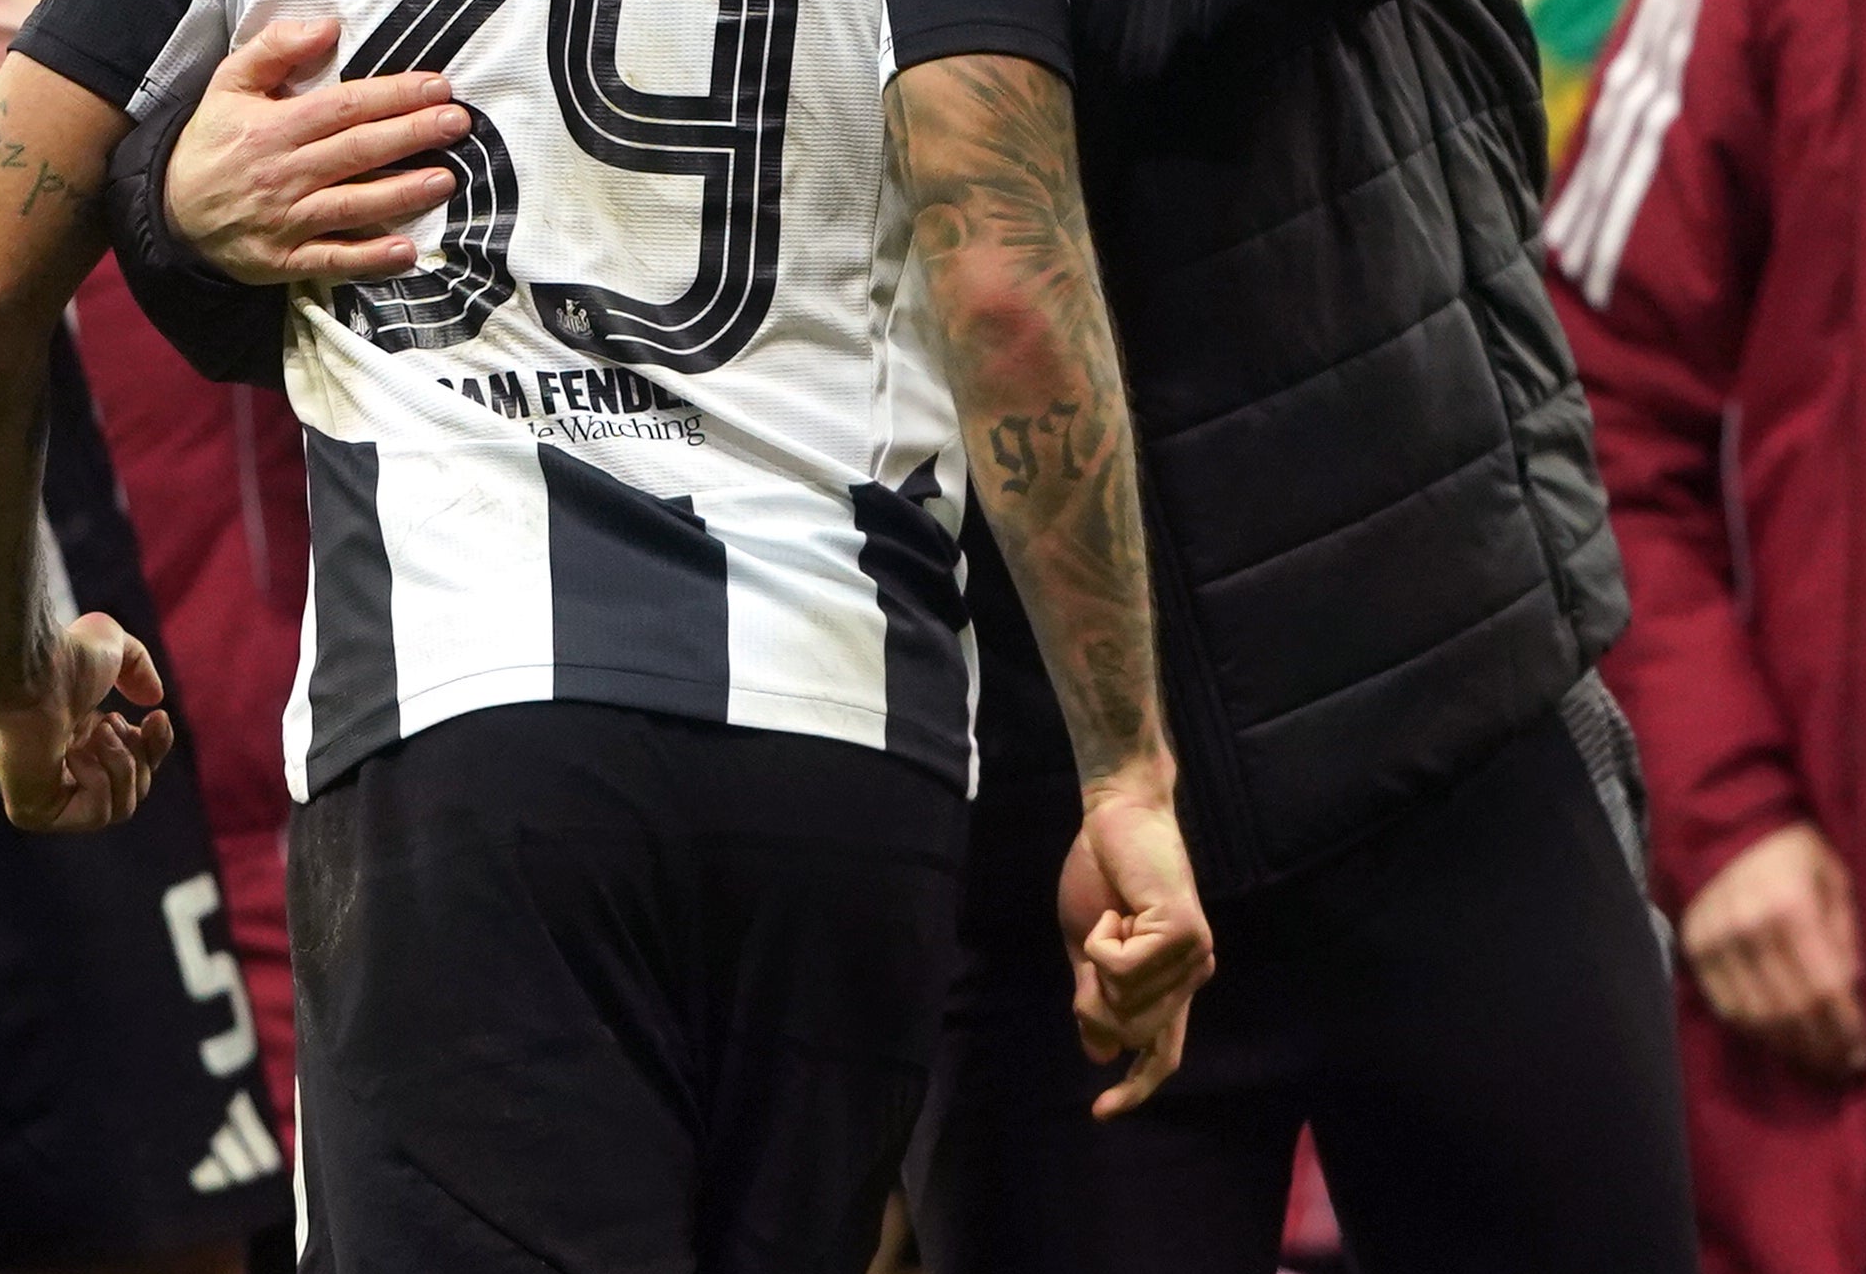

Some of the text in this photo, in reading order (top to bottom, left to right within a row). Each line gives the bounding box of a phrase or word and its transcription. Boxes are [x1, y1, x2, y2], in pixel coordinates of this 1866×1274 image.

[436, 371, 531, 419] AM
[556, 412, 706, 446] Watching
[161, 871, 258, 1078] 5
